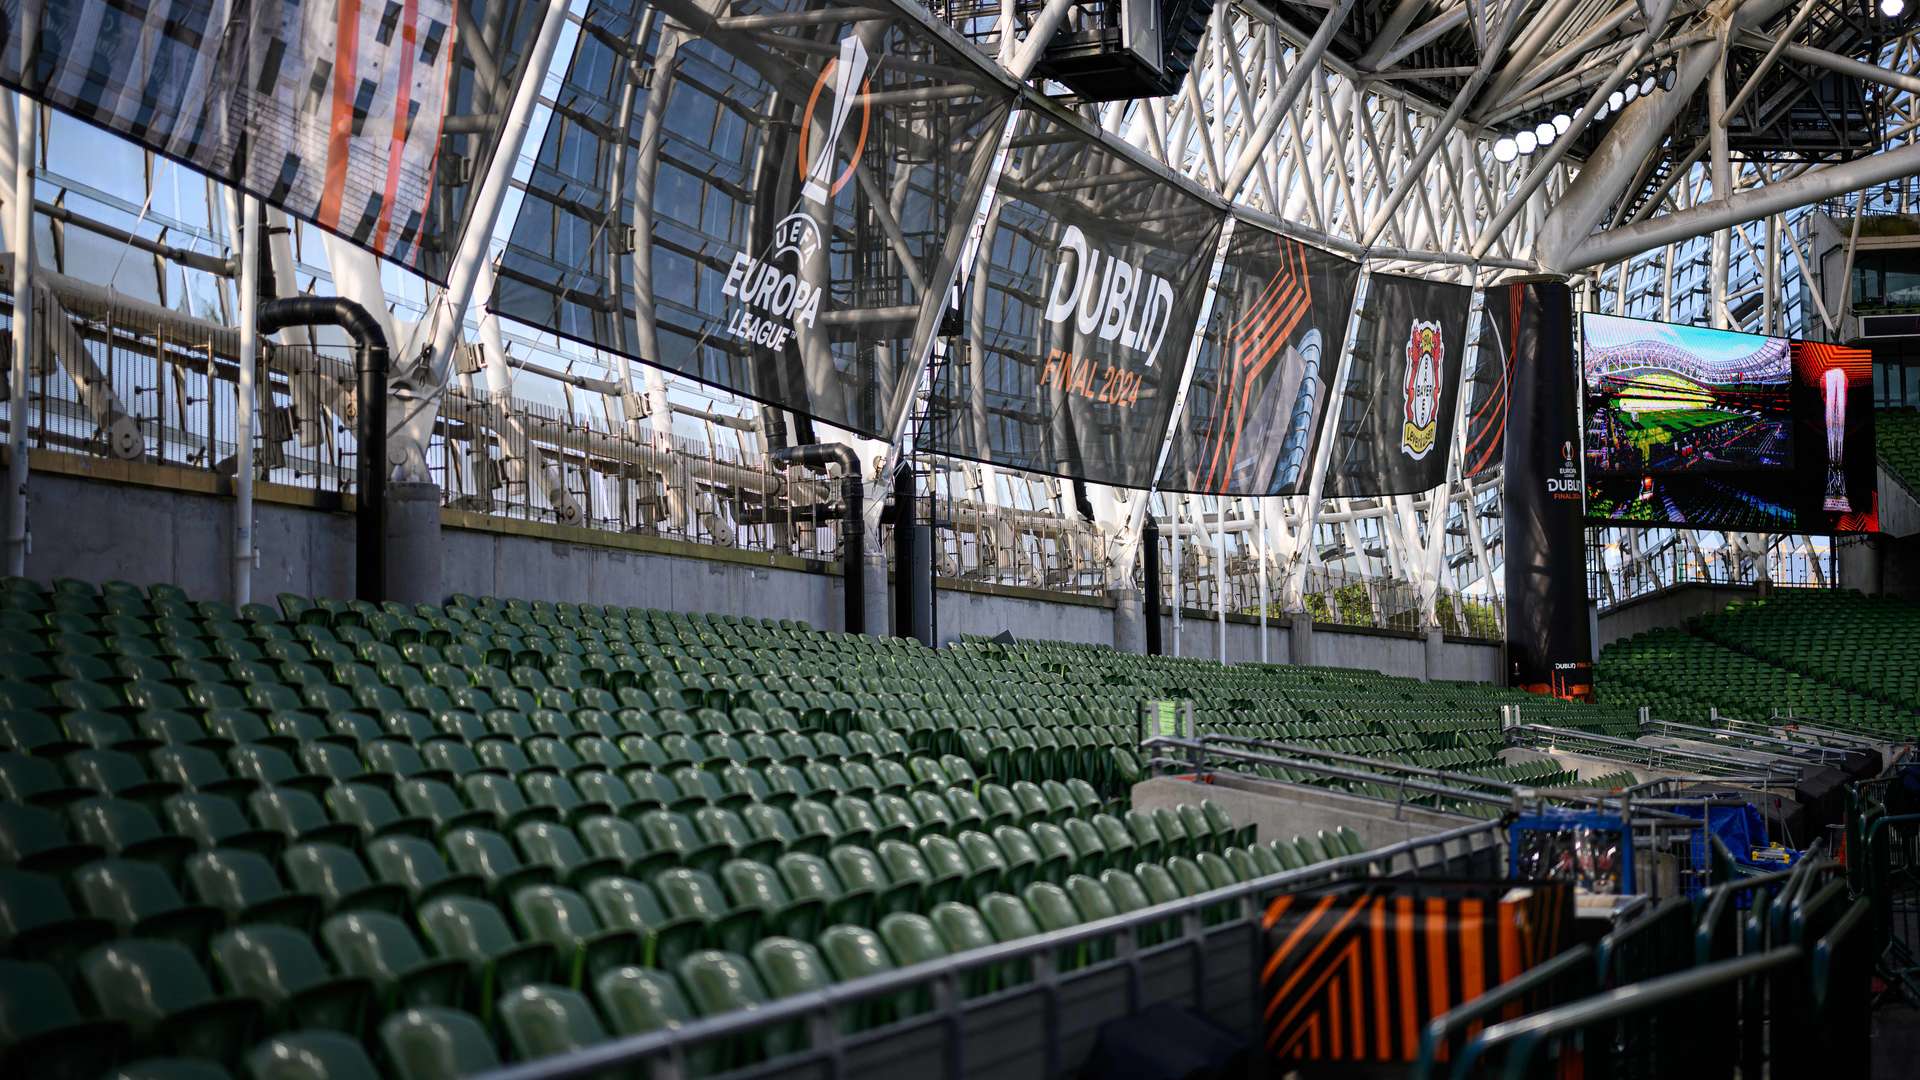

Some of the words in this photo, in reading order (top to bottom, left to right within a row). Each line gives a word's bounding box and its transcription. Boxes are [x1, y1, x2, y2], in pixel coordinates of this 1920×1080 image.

[776, 221, 816, 264] UEFA
[721, 251, 822, 329] EUROPA
[1045, 225, 1174, 367] DUBLIN
[727, 309, 790, 352] LEAGUE
[1041, 347, 1098, 399] FINAL
[1098, 366, 1142, 409] 2024
[1547, 478, 1581, 493] DUBLIN
